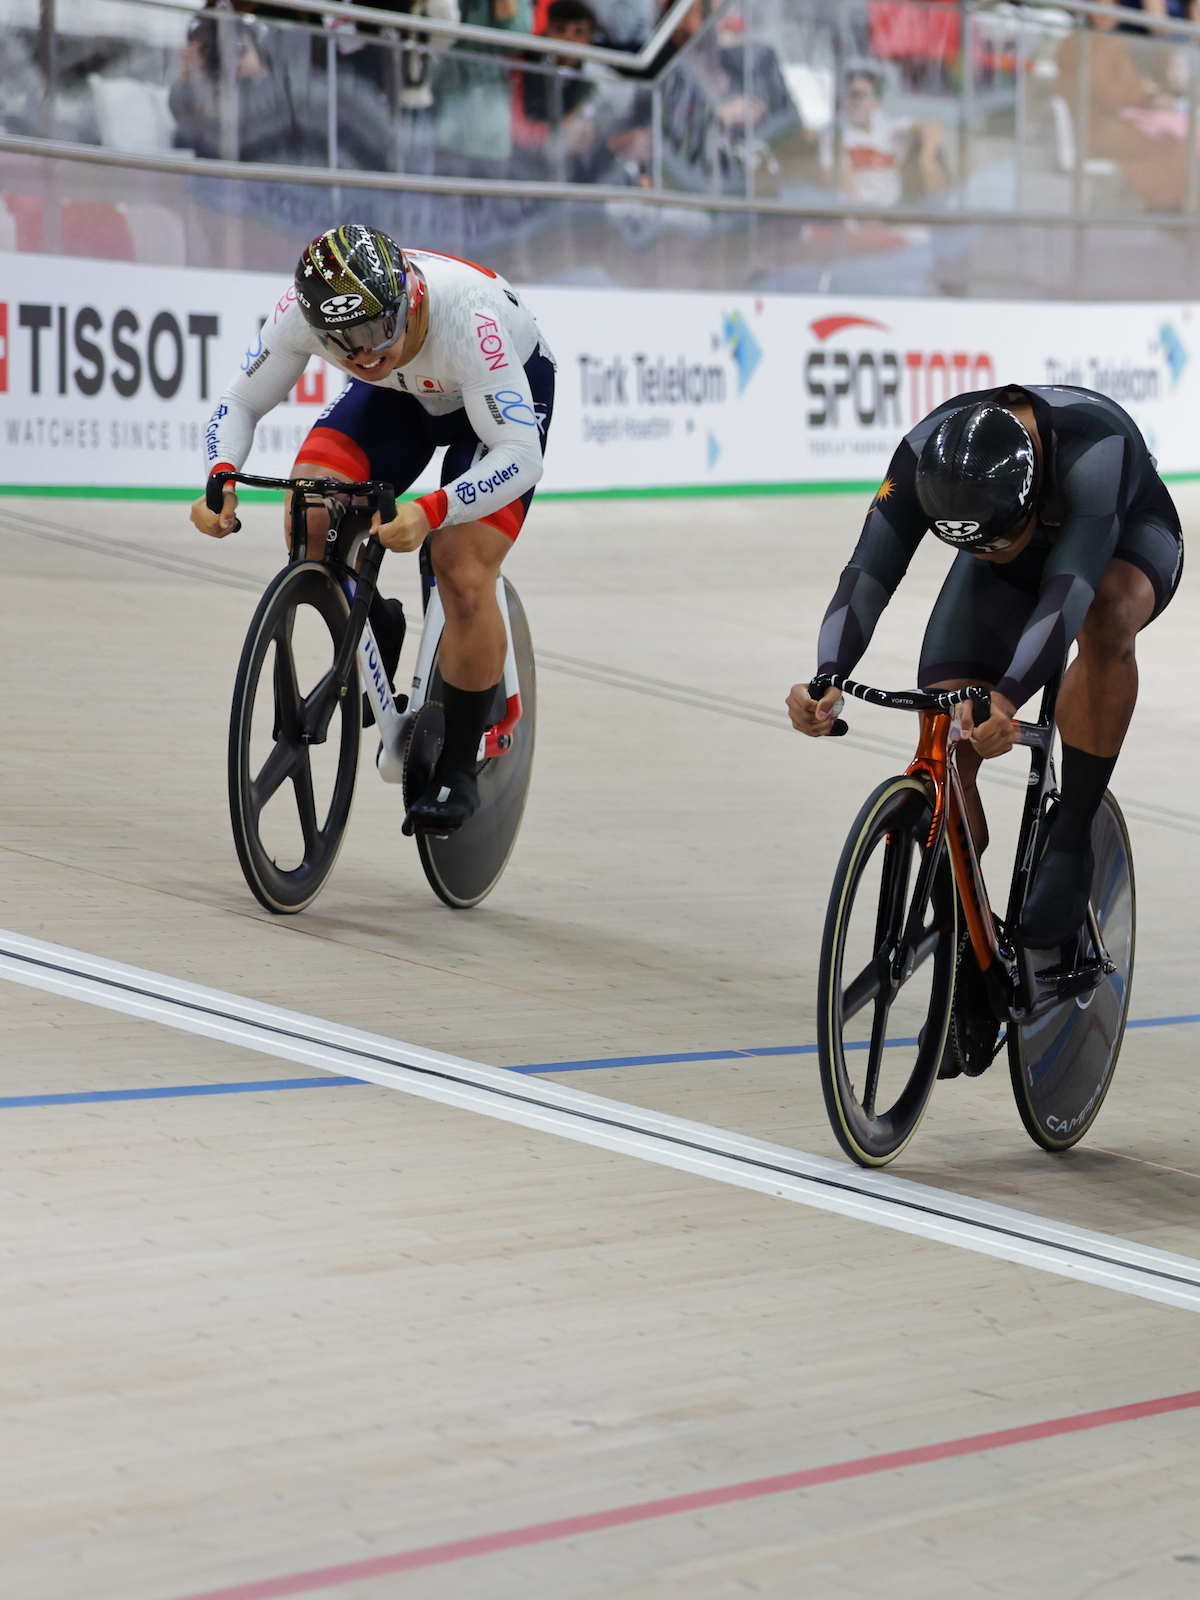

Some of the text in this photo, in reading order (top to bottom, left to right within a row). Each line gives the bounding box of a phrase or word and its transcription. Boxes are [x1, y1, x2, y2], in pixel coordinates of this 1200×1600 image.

[323, 309, 367, 324] Kabuto
[18, 303, 220, 401] TISSOT
[246, 349, 271, 378] KEIRIN
[632, 352, 727, 406] Telekom
[484, 394, 506, 425] KEIRIN
[6, 418, 101, 449] WATCHES
[110, 419, 170, 450] SINCE
[205, 423, 220, 461] Cyclers
[477, 462, 519, 493] Cyclers
